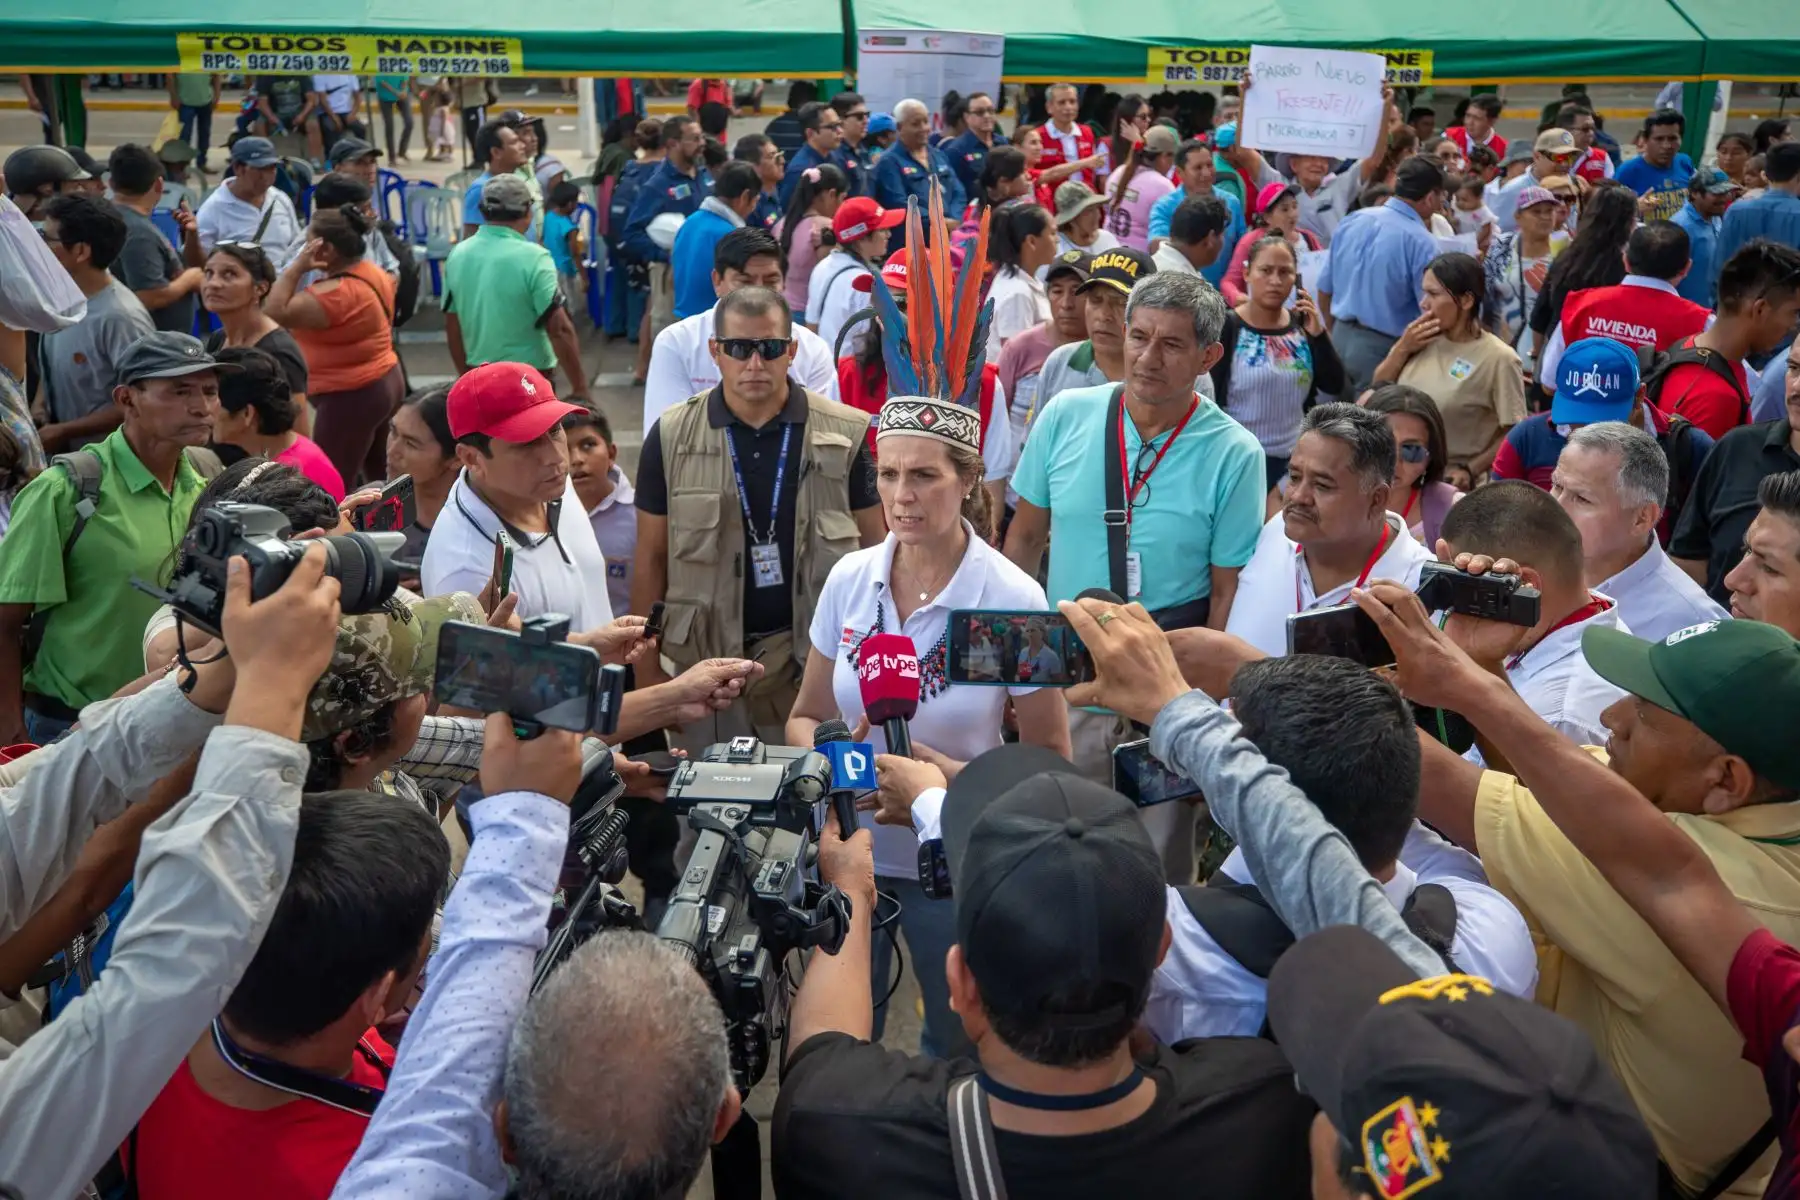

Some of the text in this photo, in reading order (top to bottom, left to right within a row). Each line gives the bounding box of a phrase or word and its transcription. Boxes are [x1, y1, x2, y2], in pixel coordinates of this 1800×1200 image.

[197, 36, 507, 55] TOLDOS NADINE
[203, 54, 241, 70] RPC:
[378, 57, 412, 73] RPC:
[1165, 50, 1250, 64] TOLD
[1090, 253, 1139, 277] POLICIA
[1588, 316, 1657, 342] VIVIENDA
[1566, 370, 1620, 390] JORDAN
